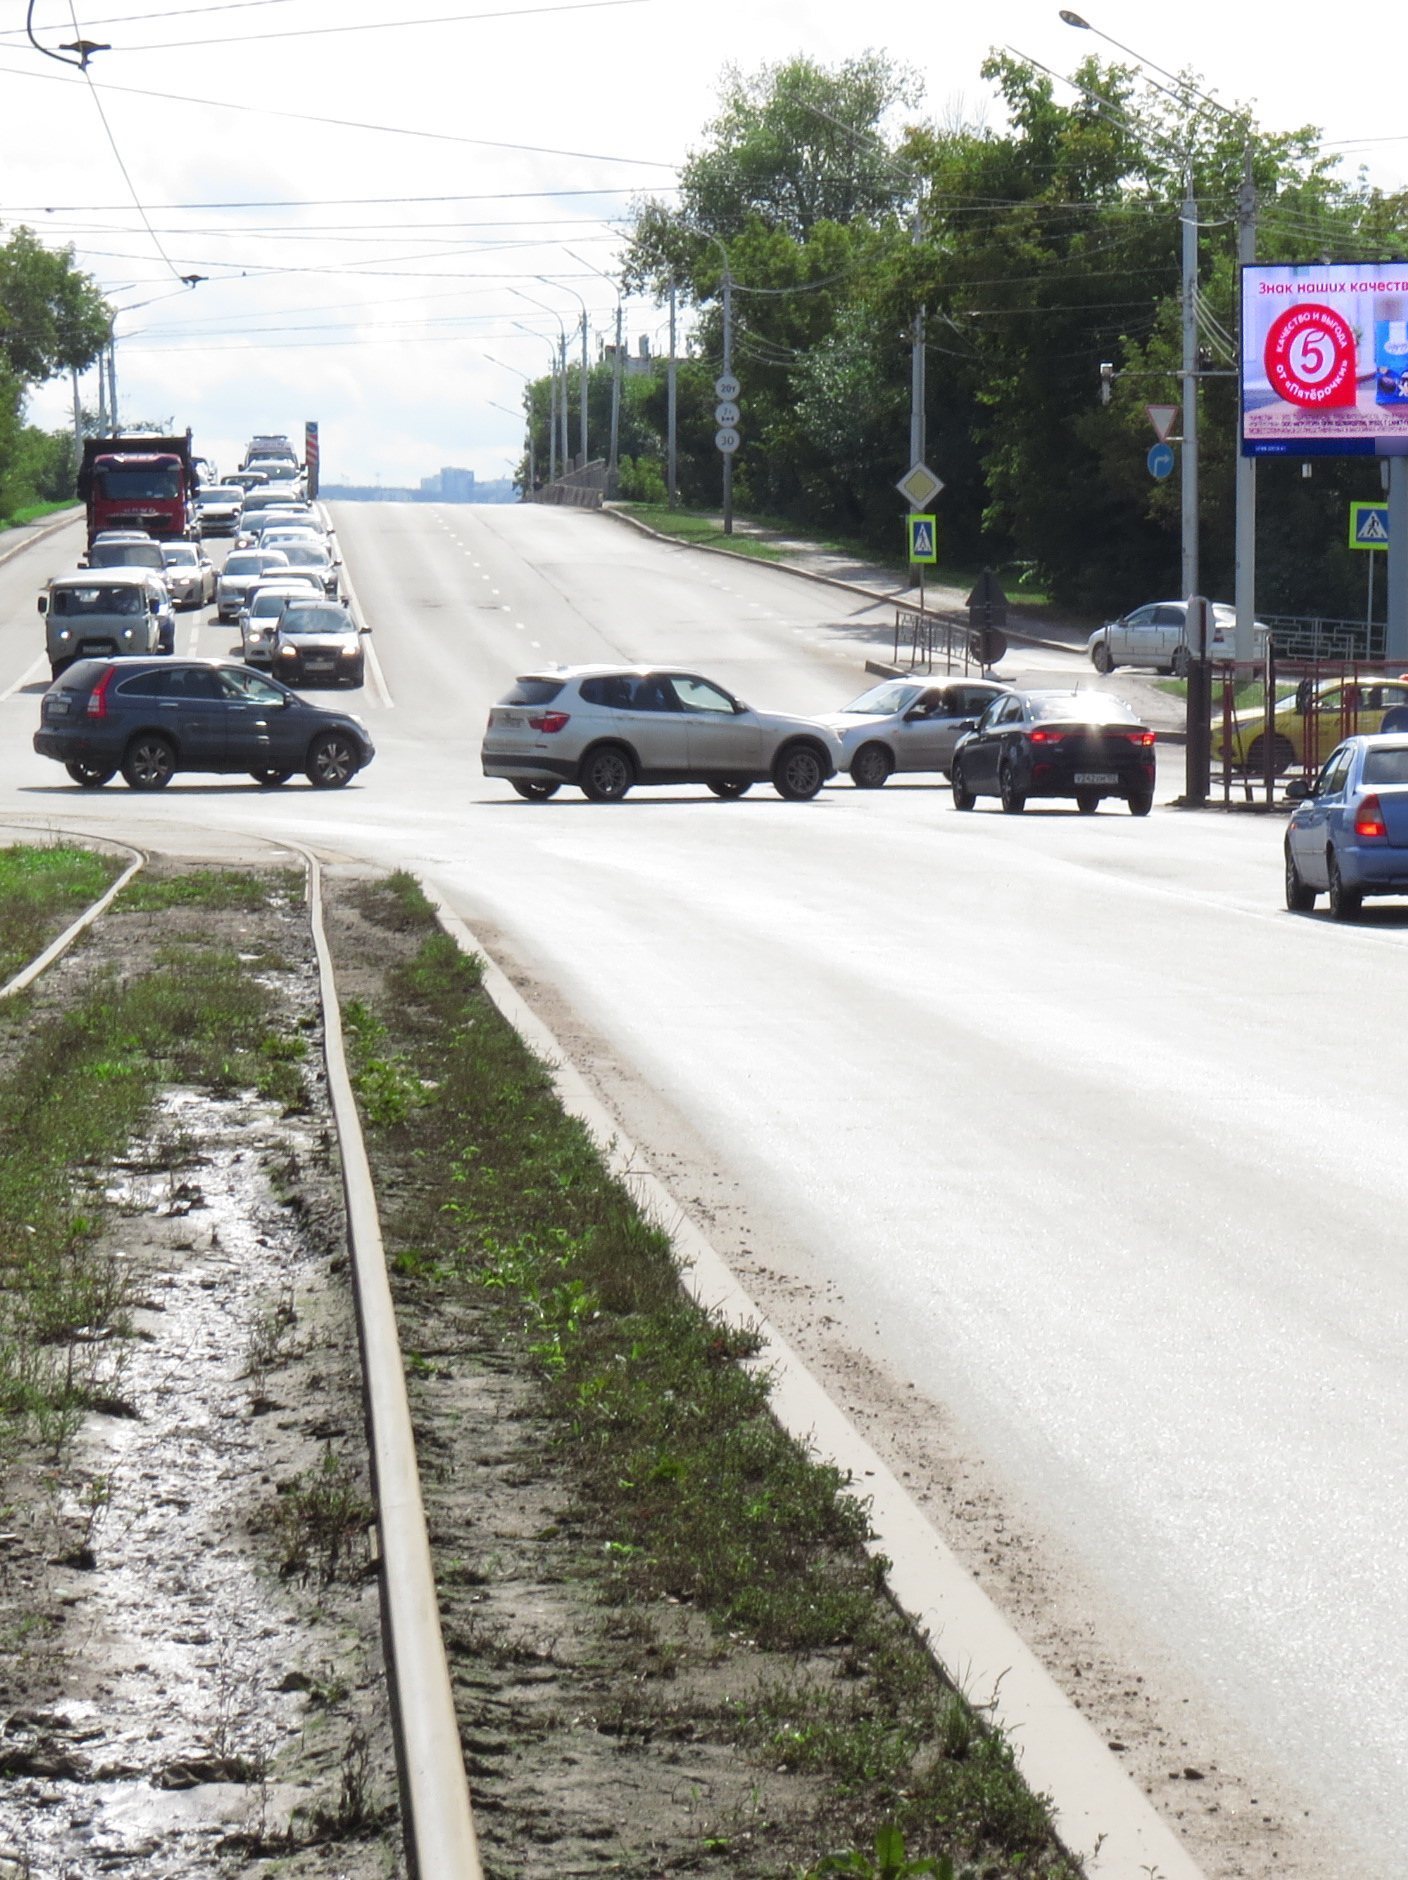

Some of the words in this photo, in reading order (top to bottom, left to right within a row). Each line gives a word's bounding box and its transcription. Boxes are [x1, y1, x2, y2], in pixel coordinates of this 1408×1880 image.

[1258, 282, 1293, 294] Знак
[1297, 281, 1346, 293] наших
[1276, 313, 1310, 352] КАЧЕСТВО
[1321, 314, 1348, 348] ВЫГОДА
